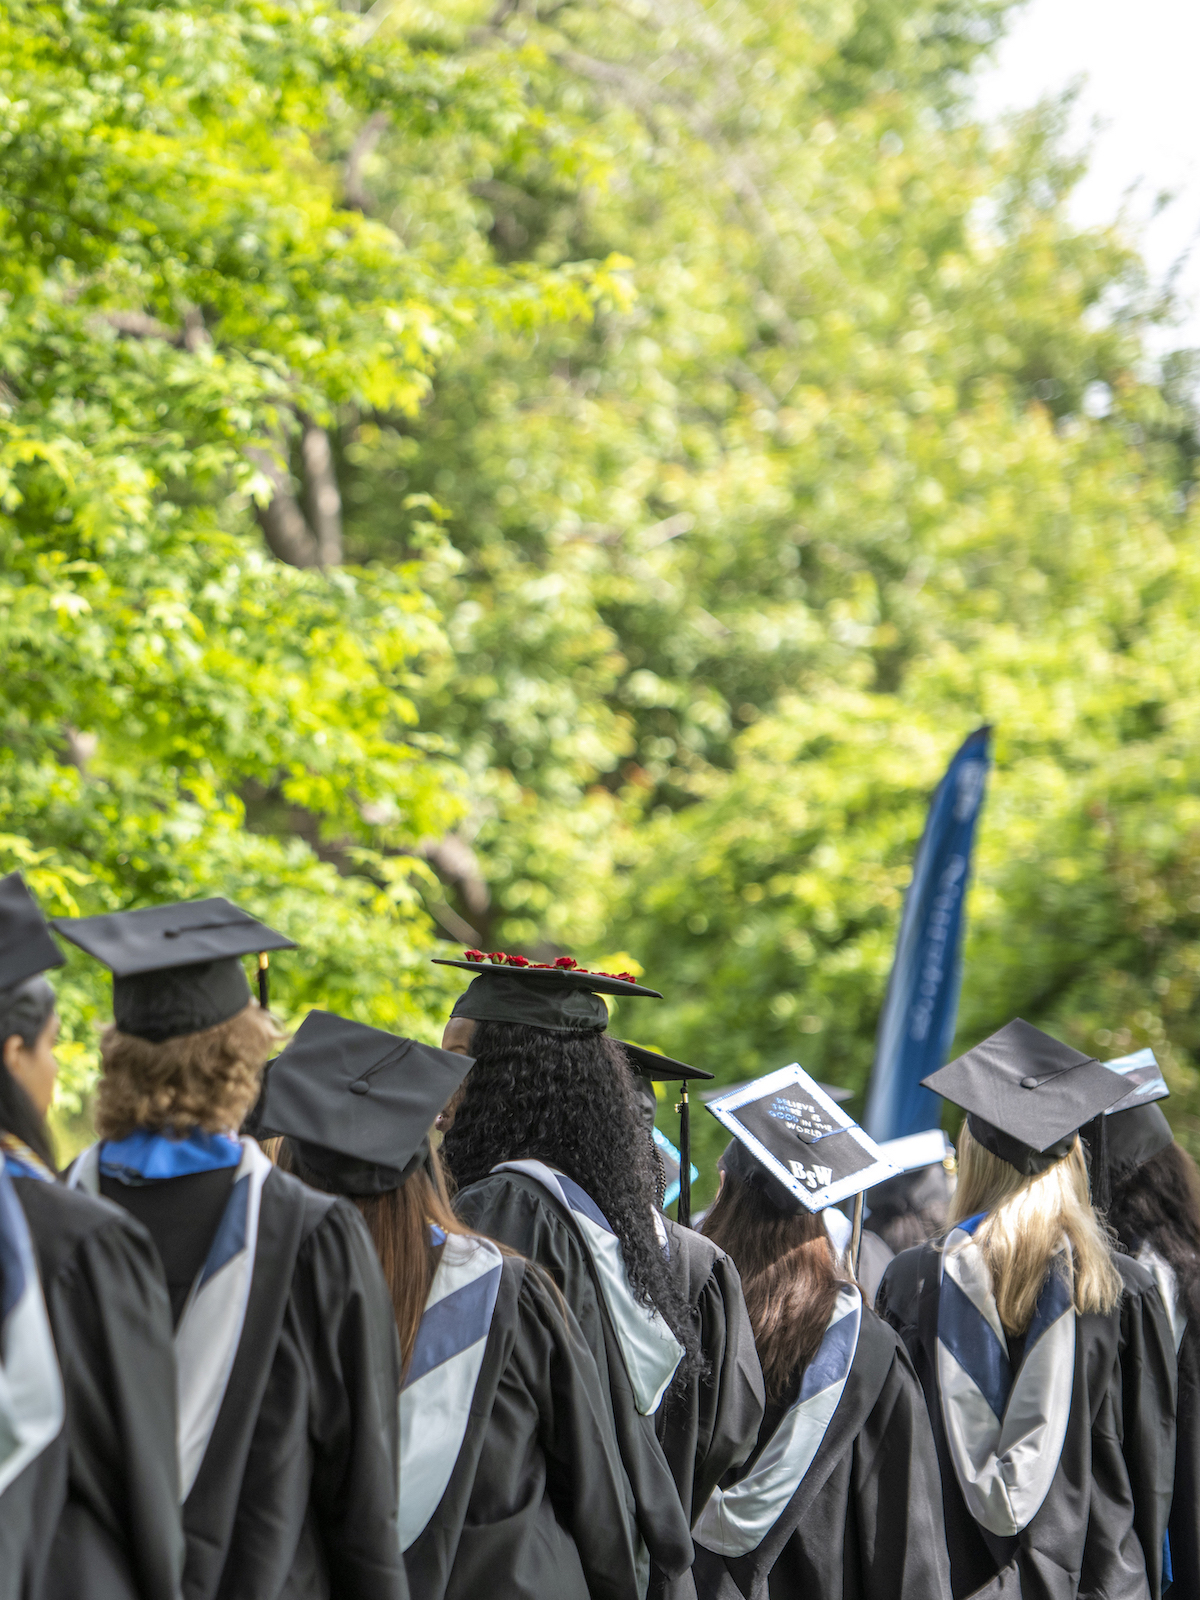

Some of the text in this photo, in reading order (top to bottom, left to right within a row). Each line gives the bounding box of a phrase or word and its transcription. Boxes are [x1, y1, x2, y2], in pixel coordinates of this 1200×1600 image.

[775, 1097, 815, 1113] BELIEVE
[768, 1110, 833, 1132] GOOD IN THE
[785, 1121, 823, 1138] WORLD
